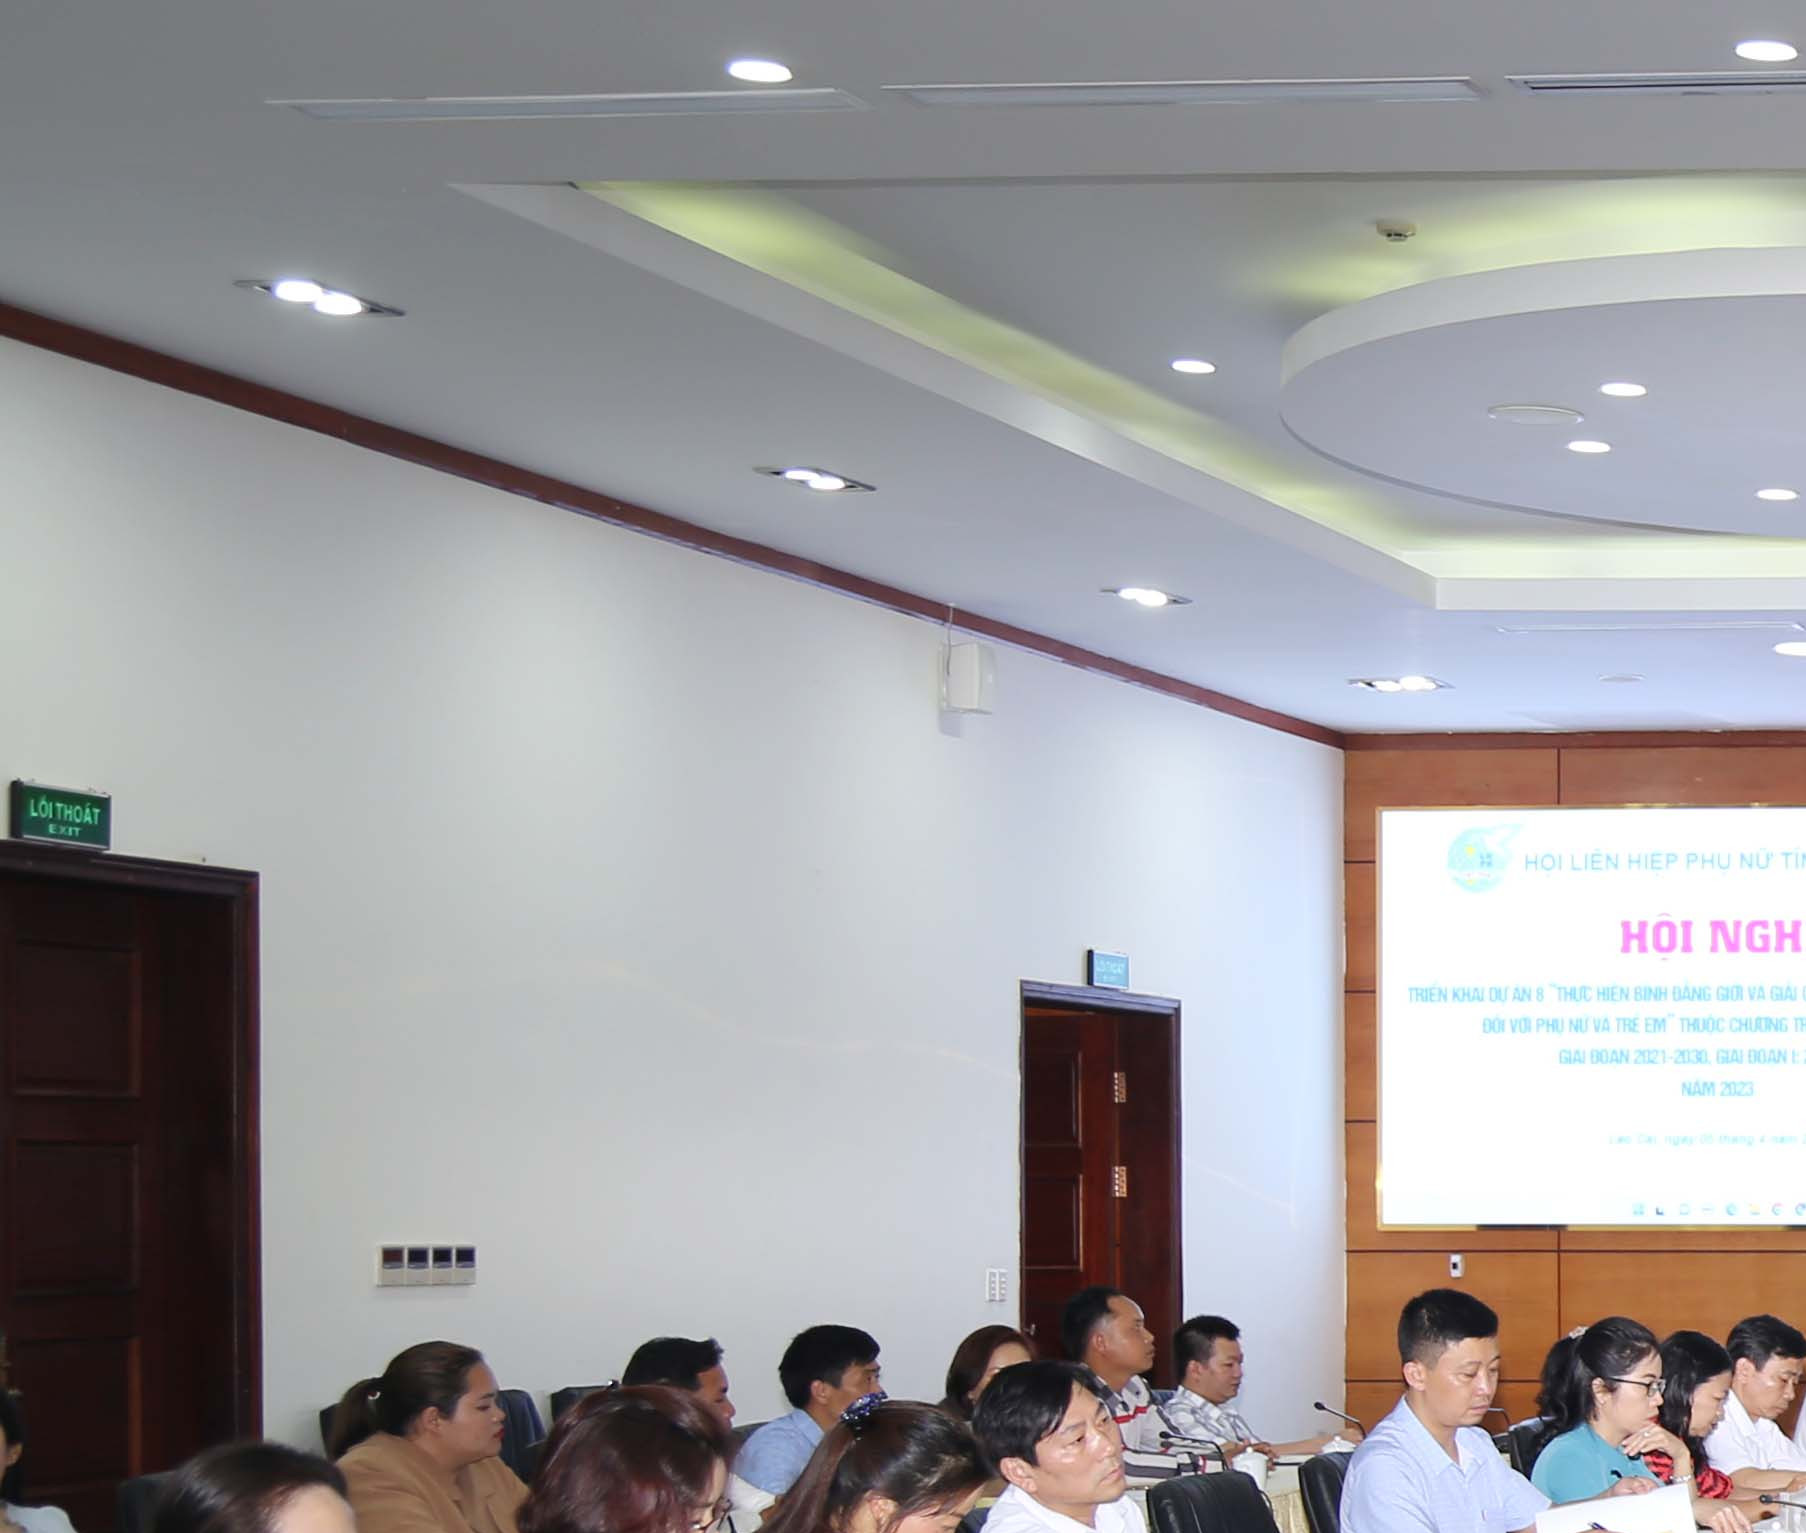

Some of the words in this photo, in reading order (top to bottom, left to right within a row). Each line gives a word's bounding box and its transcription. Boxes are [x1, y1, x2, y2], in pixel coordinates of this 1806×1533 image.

[55, 802, 101, 825] THOÁT
[48, 823, 82, 837] EXIT
[1620, 913, 1693, 961] HỘI
[1720, 1081, 1754, 1097] 2023
